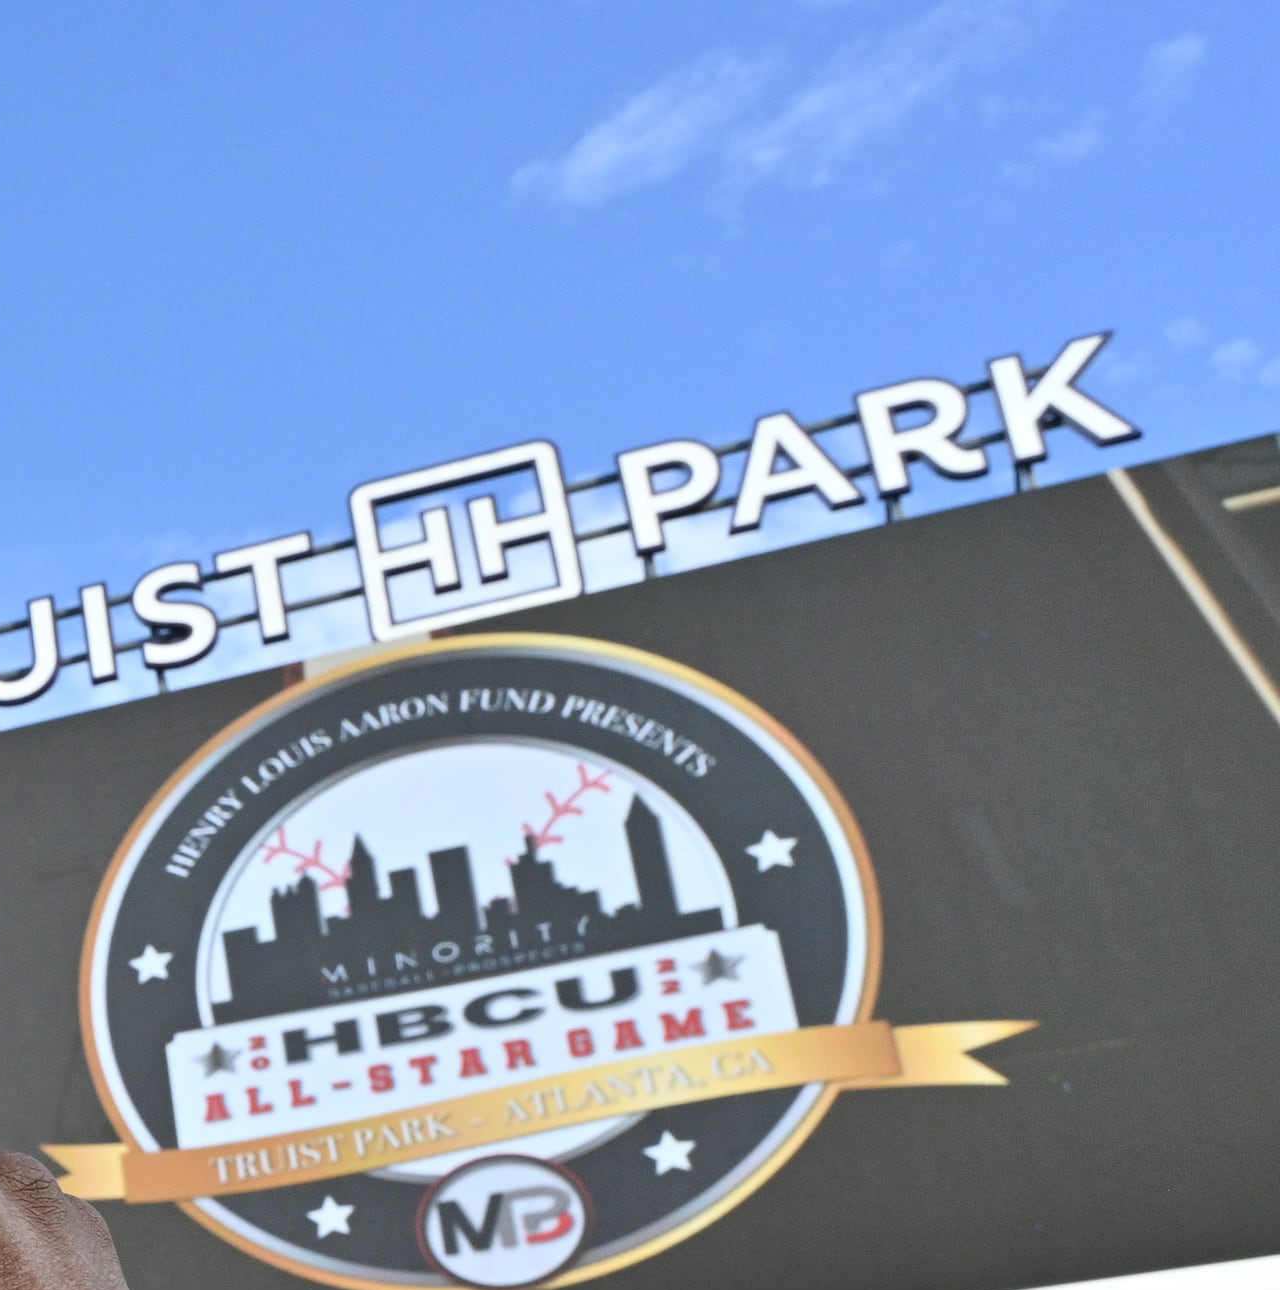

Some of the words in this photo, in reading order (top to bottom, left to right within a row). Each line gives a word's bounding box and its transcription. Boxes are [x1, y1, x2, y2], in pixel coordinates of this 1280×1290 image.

[616, 331, 1142, 557] PARK
[165, 788, 244, 878] HENRY
[241, 728, 333, 794] LOUIS
[340, 692, 449, 741] AARON
[460, 687, 555, 714] FUND
[561, 694, 717, 777] PRESENTS
[320, 915, 589, 982] MINORITY
[204, 1039, 535, 1122] ALL-STAR
[567, 998, 754, 1058] GAME
[282, 967, 641, 1065] HBCU
[208, 1129, 352, 1185] TRUIST
[355, 1114, 457, 1156] PARK
